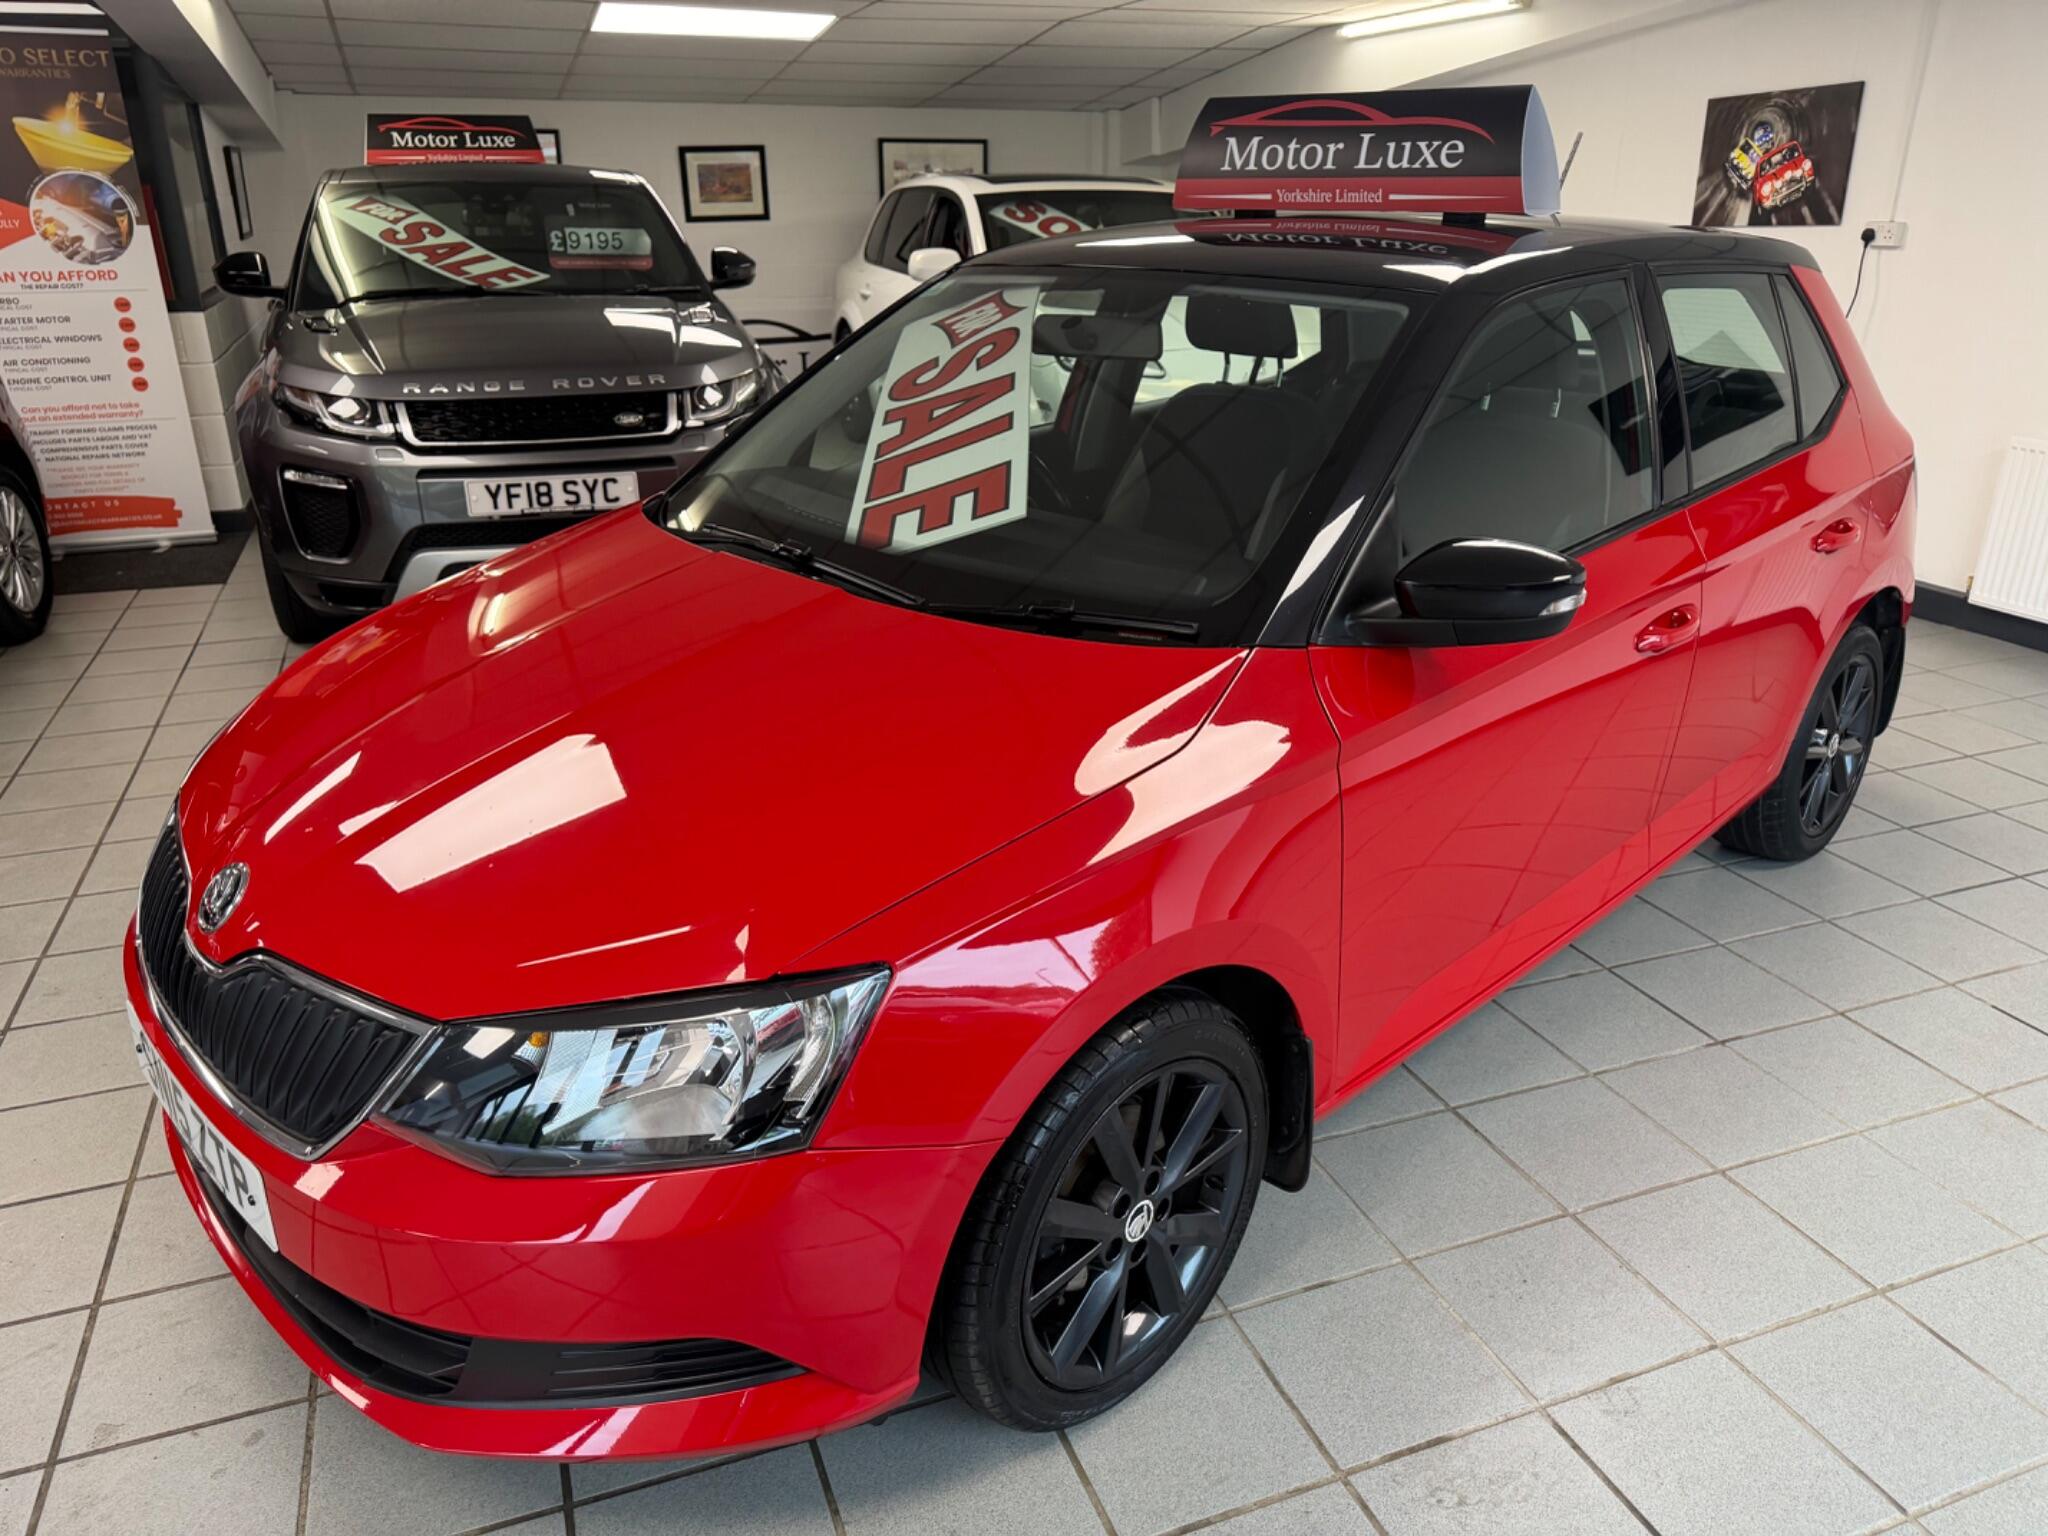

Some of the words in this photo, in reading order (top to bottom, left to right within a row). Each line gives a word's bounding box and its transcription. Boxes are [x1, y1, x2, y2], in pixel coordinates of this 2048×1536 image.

[23, 47, 109, 68] SELECT
[390, 131, 458, 148] Motor
[464, 131, 516, 148] Luxe
[1220, 136, 1344, 171] Motor
[1354, 132, 1465, 169] Luxe
[1277, 188, 1332, 203] Yorkshire
[1334, 188, 1383, 203] Limited
[355, 202, 406, 223] FOR
[379, 221, 538, 289] SALE
[18, 270, 53, 282] YOU
[57, 268, 118, 282] AFFORD
[36, 315, 71, 323] MOTOR
[54, 334, 103, 343] WINDOWS
[3, 359, 18, 367] AIR
[21, 356, 91, 366] CONDITIONING
[7, 376, 41, 386] ENGINE
[44, 375, 88, 384] CONTROL
[90, 374, 112, 382] UNIT
[403, 380, 525, 393] RANGE
[553, 374, 666, 389] ROVER
[43, 405, 59, 414] you
[61, 403, 89, 412] afford
[92, 403, 106, 411] not
[109, 402, 117, 410] to
[53, 413, 96, 422] extended
[98, 410, 143, 419] warranty?
[856, 326, 1020, 550] SALE
[112, 451, 146, 459] NETWORK
[484, 482, 553, 510] YF18
[563, 478, 620, 507] SYC
[47, 501, 96, 511] ONTACT
[191, 1105, 250, 1209] ZTP
